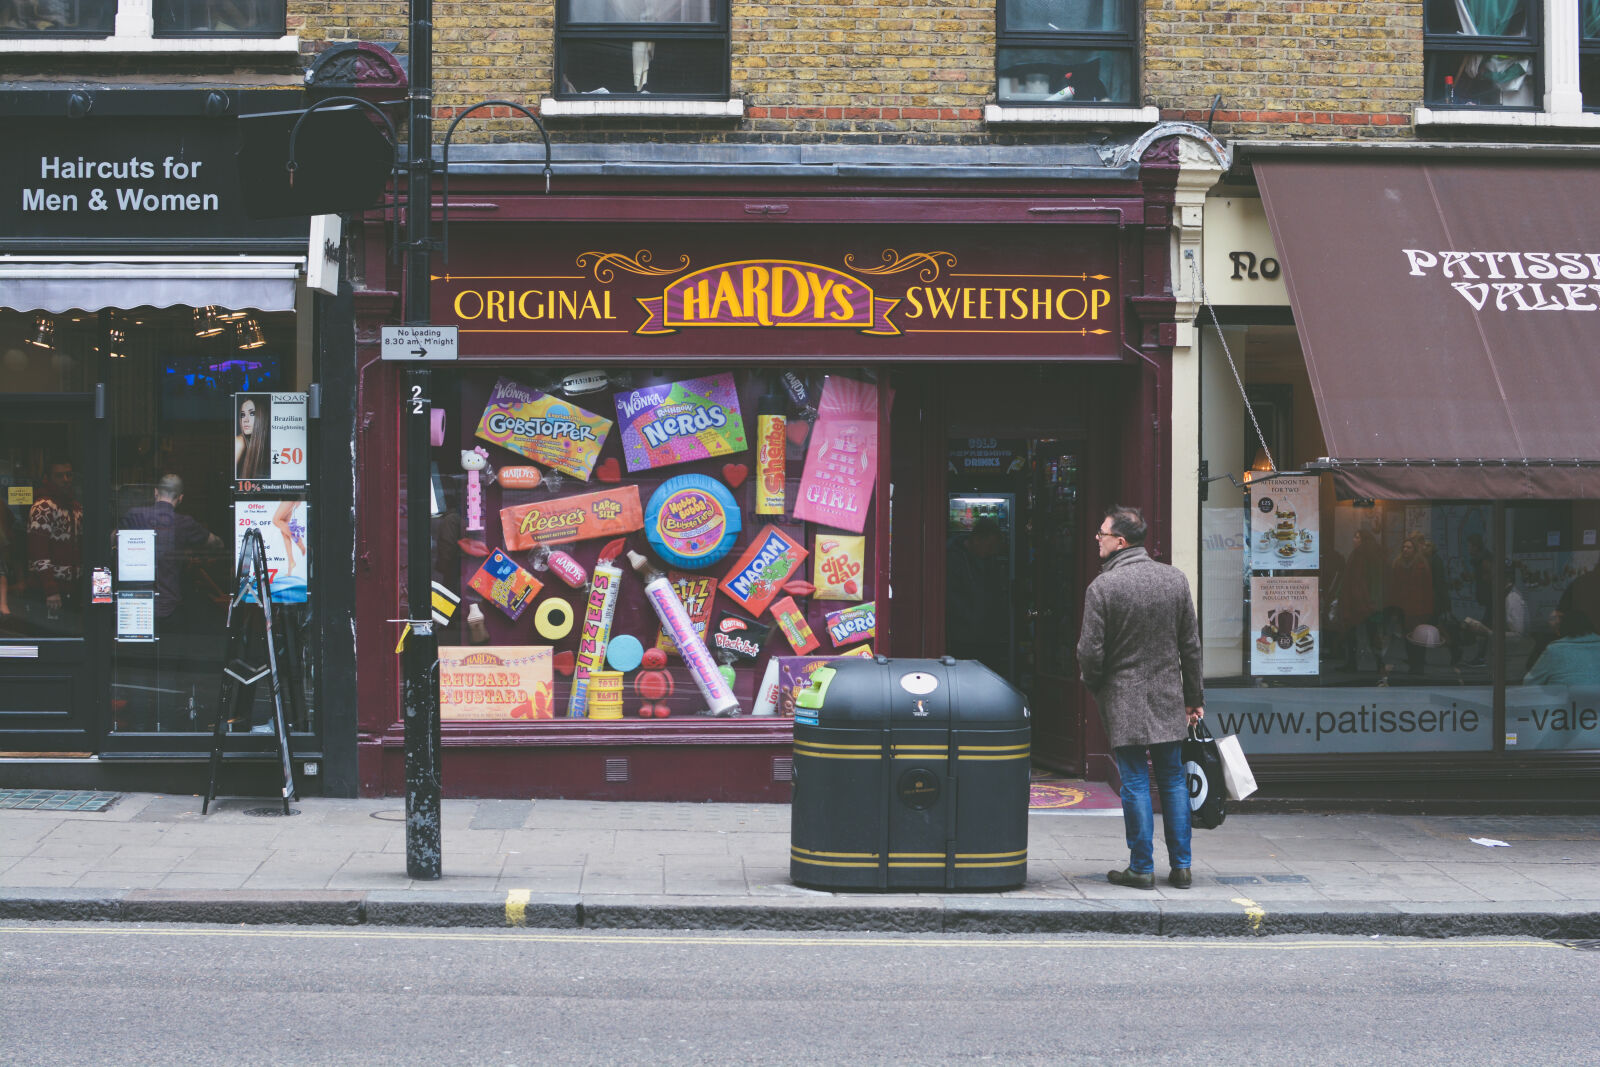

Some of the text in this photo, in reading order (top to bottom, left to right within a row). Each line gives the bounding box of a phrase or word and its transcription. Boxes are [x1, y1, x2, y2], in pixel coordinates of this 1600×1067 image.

[41, 156, 202, 180] Haircuts for
[22, 188, 219, 211] Men & Women
[453, 265, 1111, 327] ORIGINAL HARDYS SWEETSHOP
[397, 328, 441, 338] No loading
[424, 338, 454, 347] M'night
[411, 385, 422, 399] 2
[495, 382, 532, 404] WONKA
[784, 371, 807, 401] HARDYS
[271, 394, 306, 402] INOAR
[617, 391, 665, 419] WONKA
[272, 447, 303, 465] £50
[761, 416, 786, 496] Sherbet
[963, 457, 1001, 467] DRINKS
[237, 480, 261, 492] 10%
[593, 500, 621, 512] LARGE
[668, 496, 697, 514] Hubba
[806, 484, 858, 513] GIRL
[599, 510, 616, 519] SIZE
[678, 501, 707, 520] Bubba
[238, 518, 258, 527] 20%
[519, 508, 586, 535] Reese's
[555, 556, 582, 582] HARDYS
[733, 536, 785, 595] MAOAM
[821, 553, 849, 573] dip
[827, 561, 861, 585] dab
[671, 578, 709, 600] FIZZ
[576, 574, 610, 680] FIZZERS
[440, 671, 521, 688] RHUBARB
[452, 689, 529, 705] CUSTARD
[573, 681, 588, 719] GIANT
[769, 684, 779, 705] LOVE
[1217, 702, 1479, 742] www.patisserie
